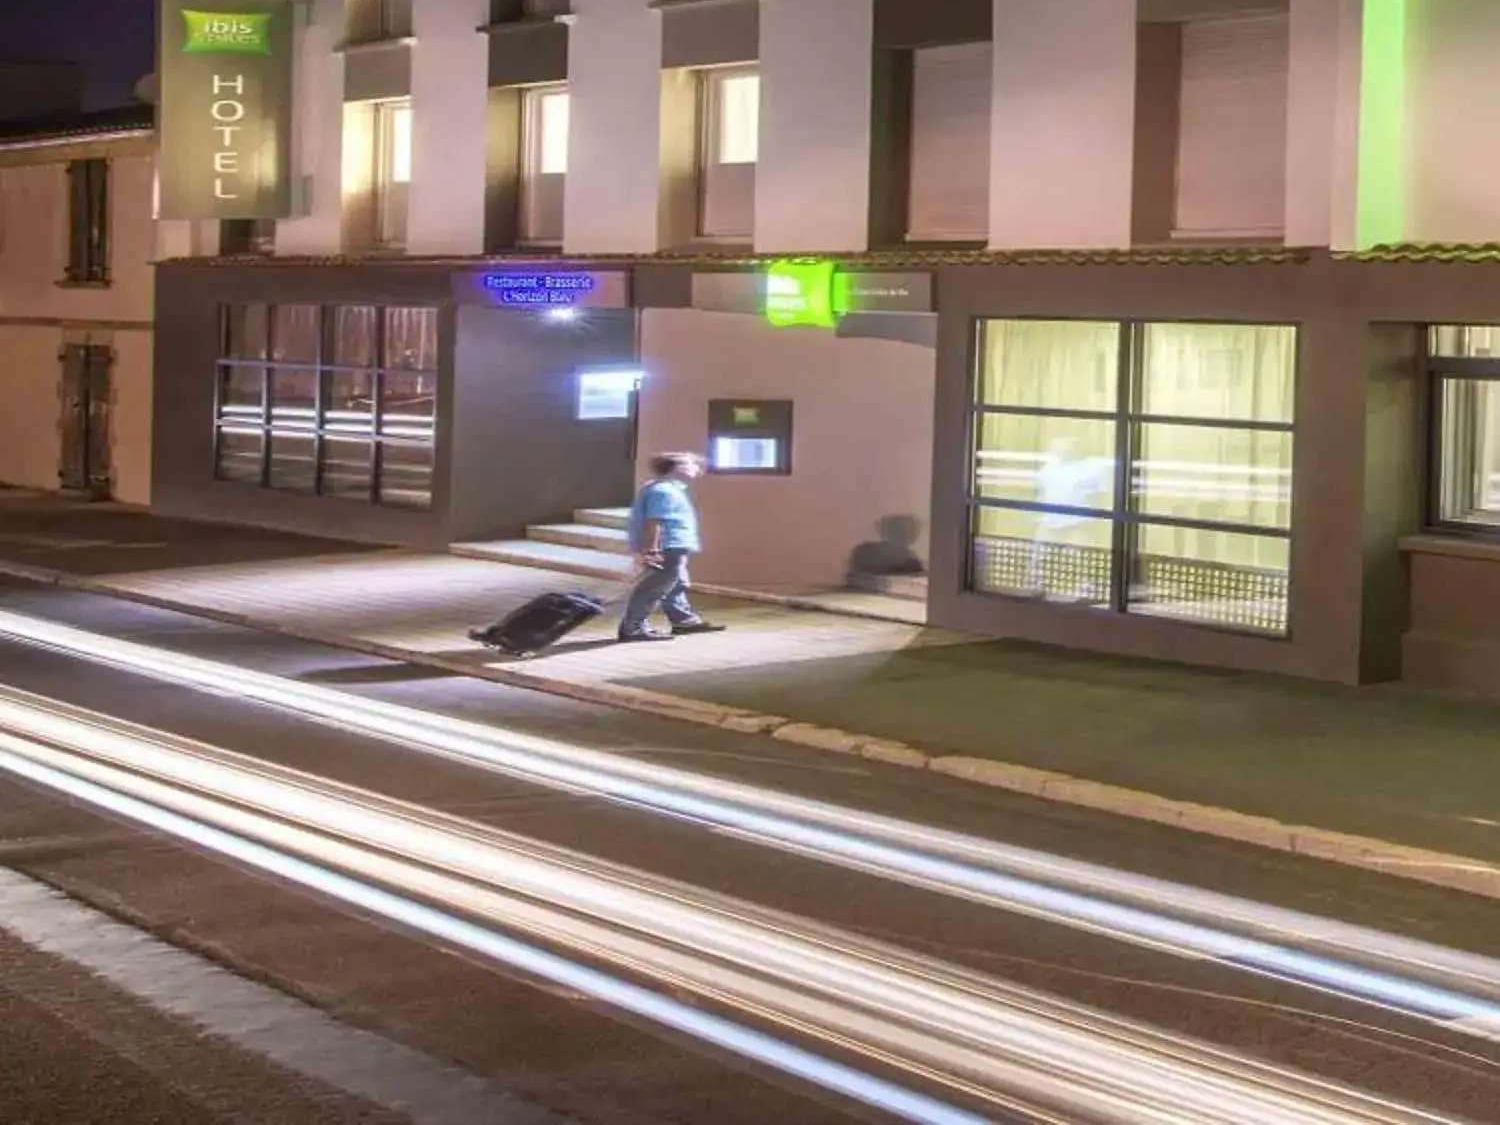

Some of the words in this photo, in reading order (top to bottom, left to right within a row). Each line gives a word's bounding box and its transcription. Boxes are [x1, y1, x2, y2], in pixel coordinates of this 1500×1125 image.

[204, 19, 254, 34] ibis
[211, 75, 245, 198] HOTEL
[487, 276, 538, 288] Restaurant
[545, 275, 592, 288] Brasserie
